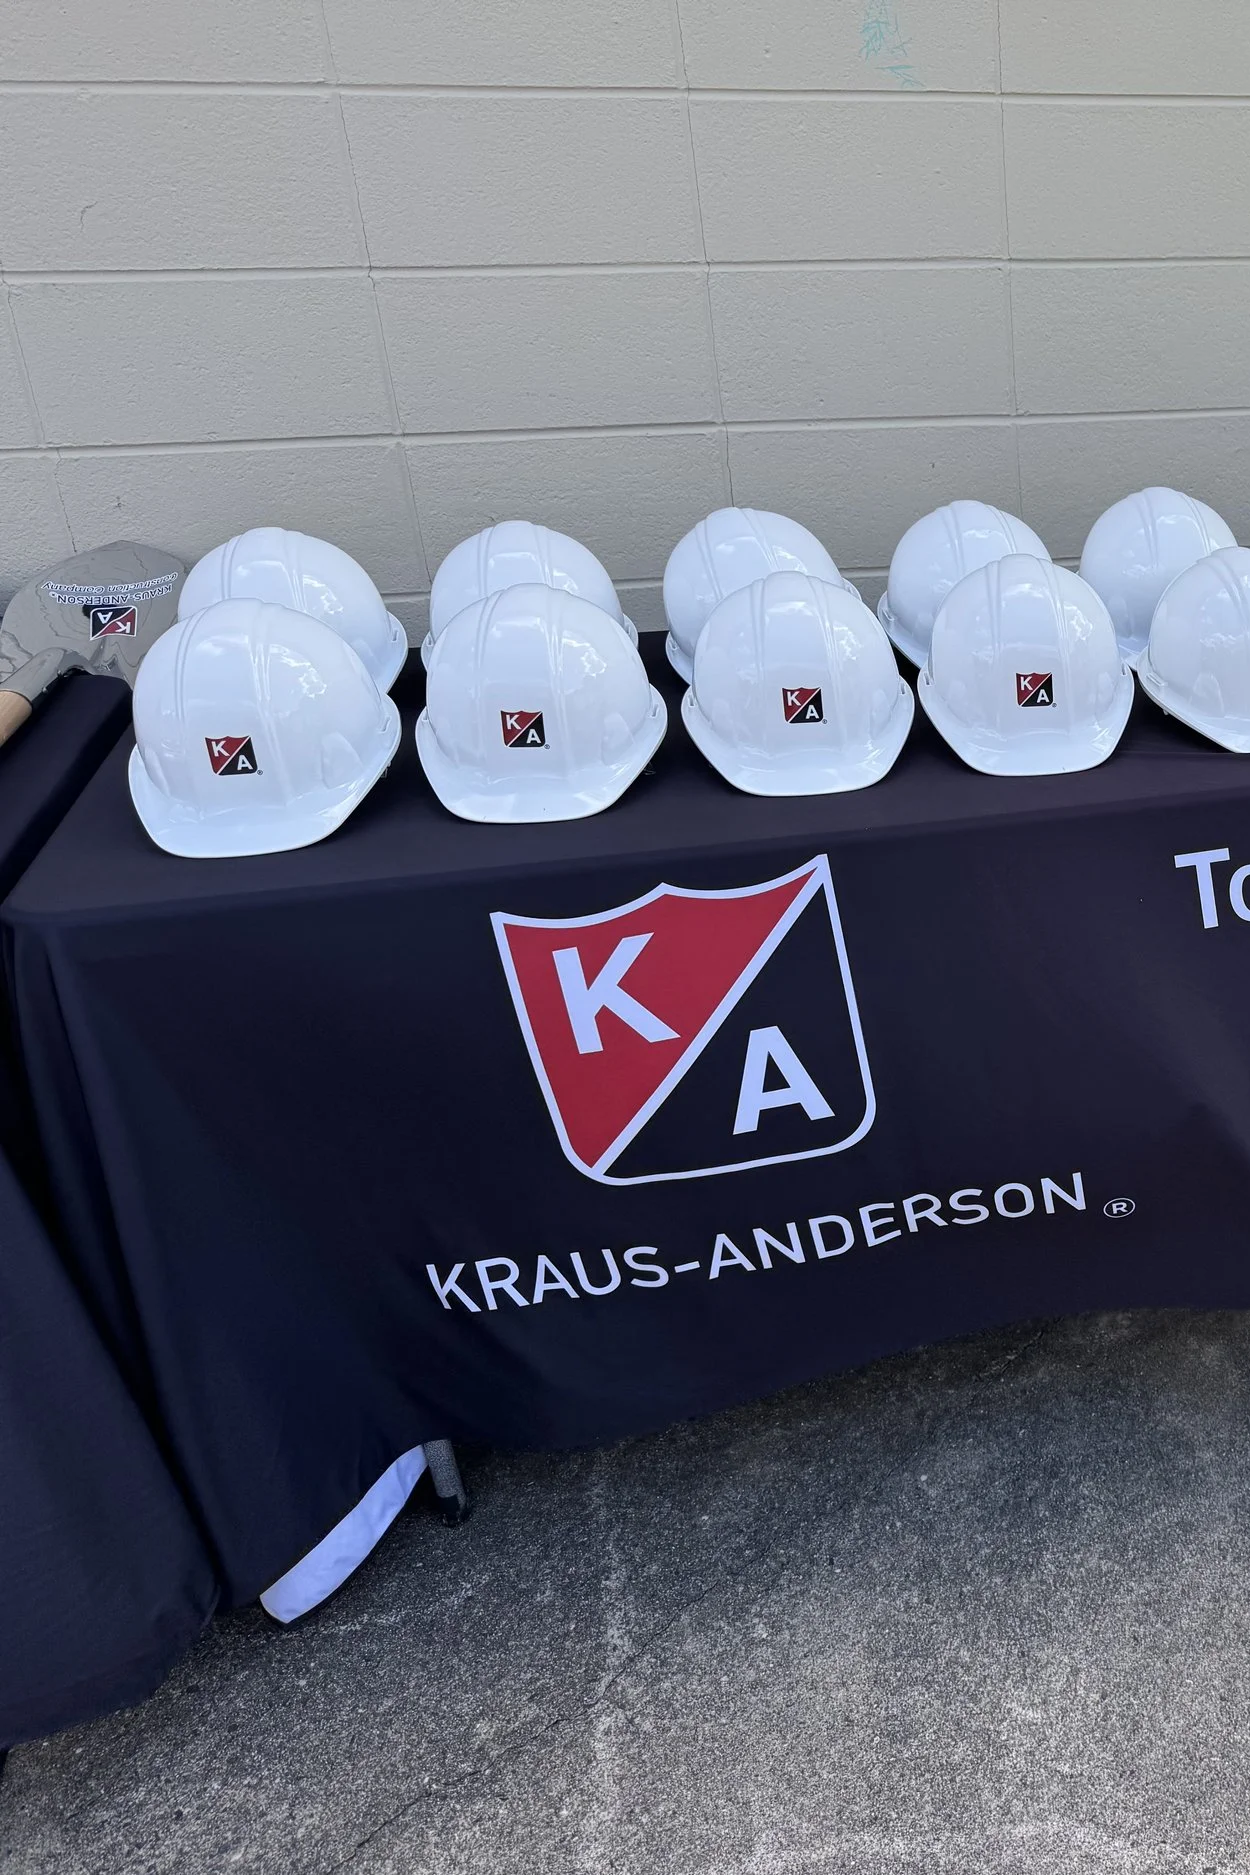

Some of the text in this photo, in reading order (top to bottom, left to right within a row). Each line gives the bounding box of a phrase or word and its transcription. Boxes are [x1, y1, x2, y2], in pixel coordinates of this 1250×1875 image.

[41, 572, 179, 594] Construction Company
[551, 931, 682, 1056] K
[732, 1025, 836, 1136] A
[425, 1171, 1087, 1313] KRAUS-ANDERSON
